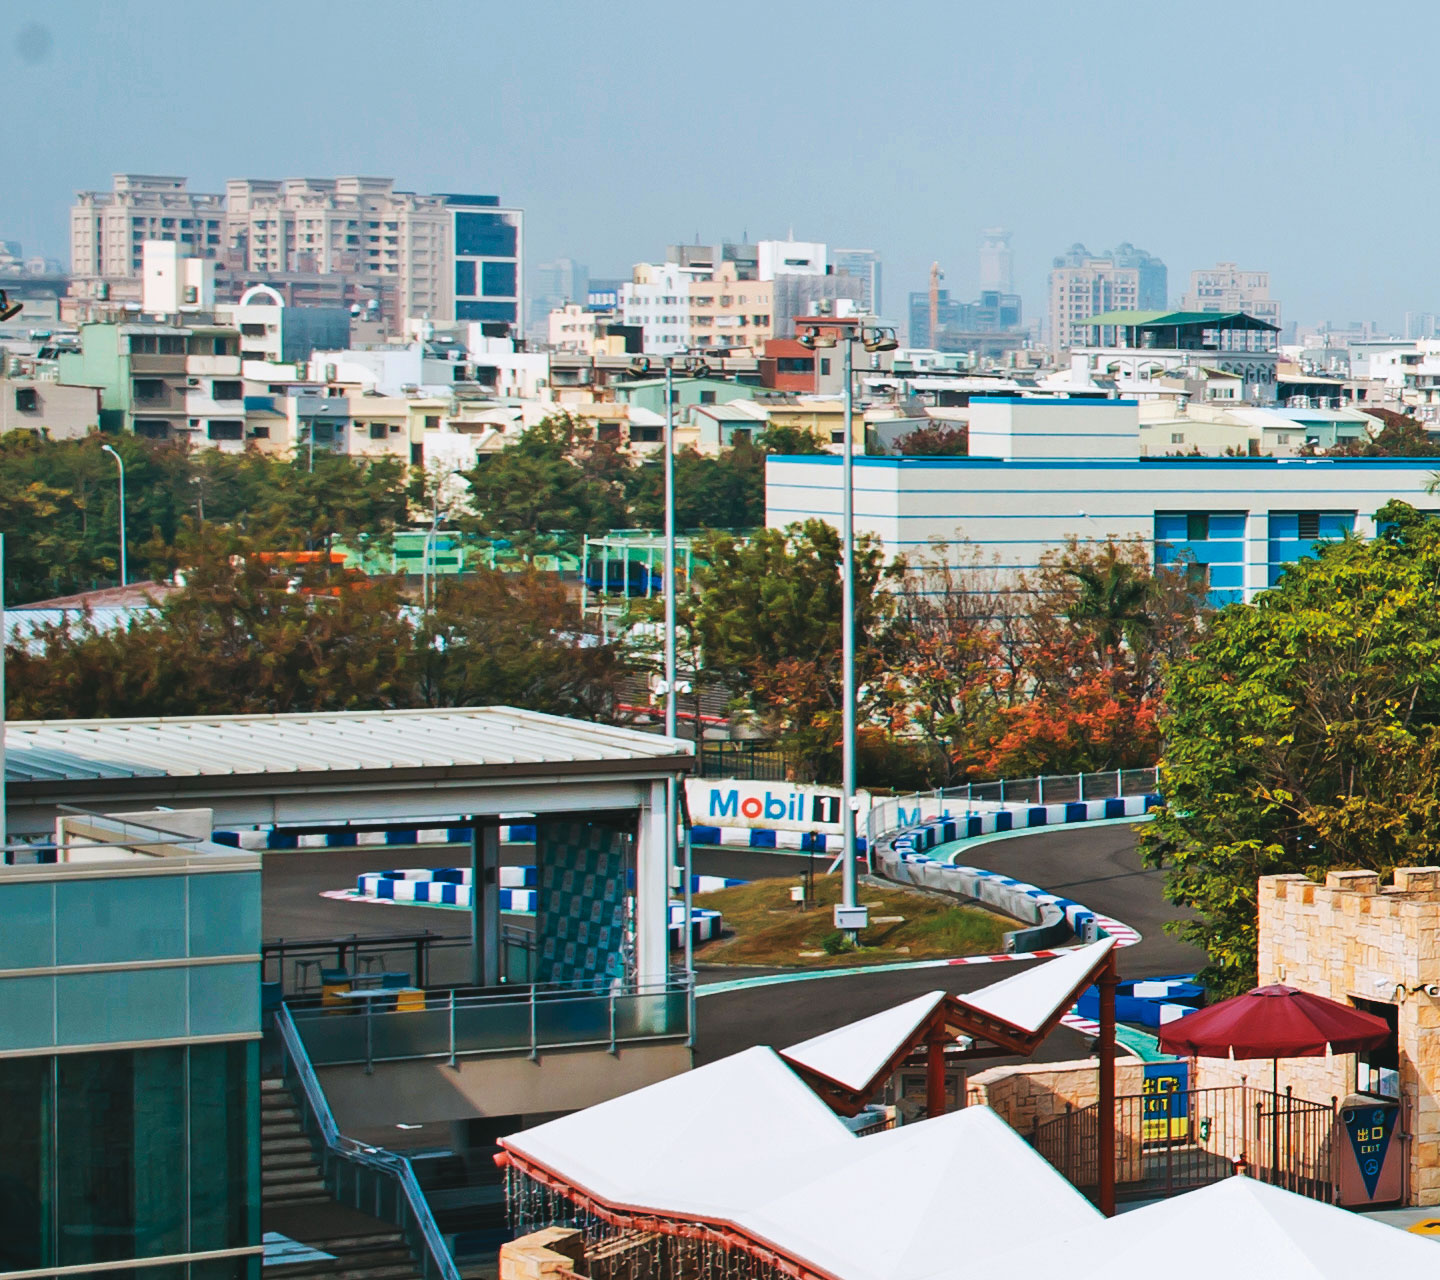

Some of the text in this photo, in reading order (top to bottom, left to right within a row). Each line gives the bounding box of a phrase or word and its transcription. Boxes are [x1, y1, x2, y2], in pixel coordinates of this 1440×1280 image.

[709, 789, 835, 823] Mobil 1
[1357, 1127, 1383, 1141] 出口
